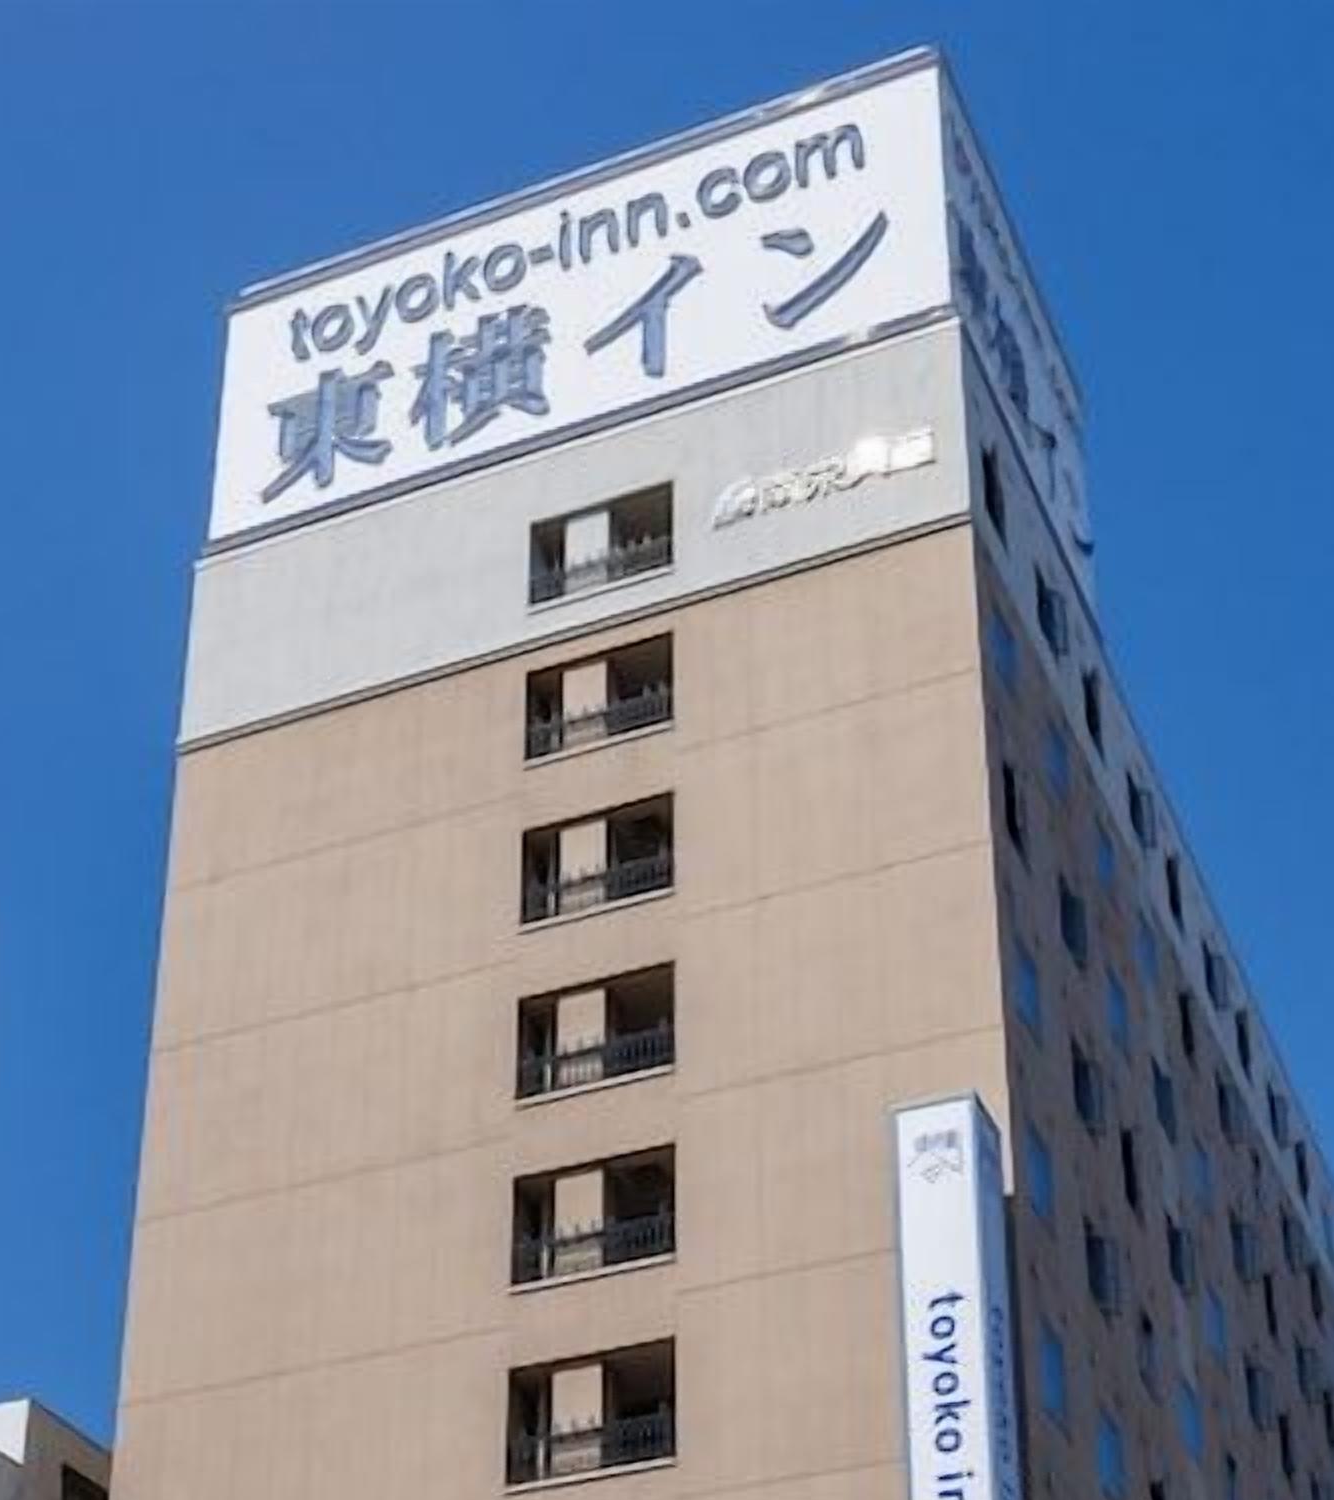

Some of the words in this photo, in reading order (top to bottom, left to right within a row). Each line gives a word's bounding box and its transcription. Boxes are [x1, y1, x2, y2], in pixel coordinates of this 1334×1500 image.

[263, 210, 889, 504] 東横イン
[288, 123, 867, 362] toyoko-inn.com
[923, 1290, 972, 1454] toyoko
